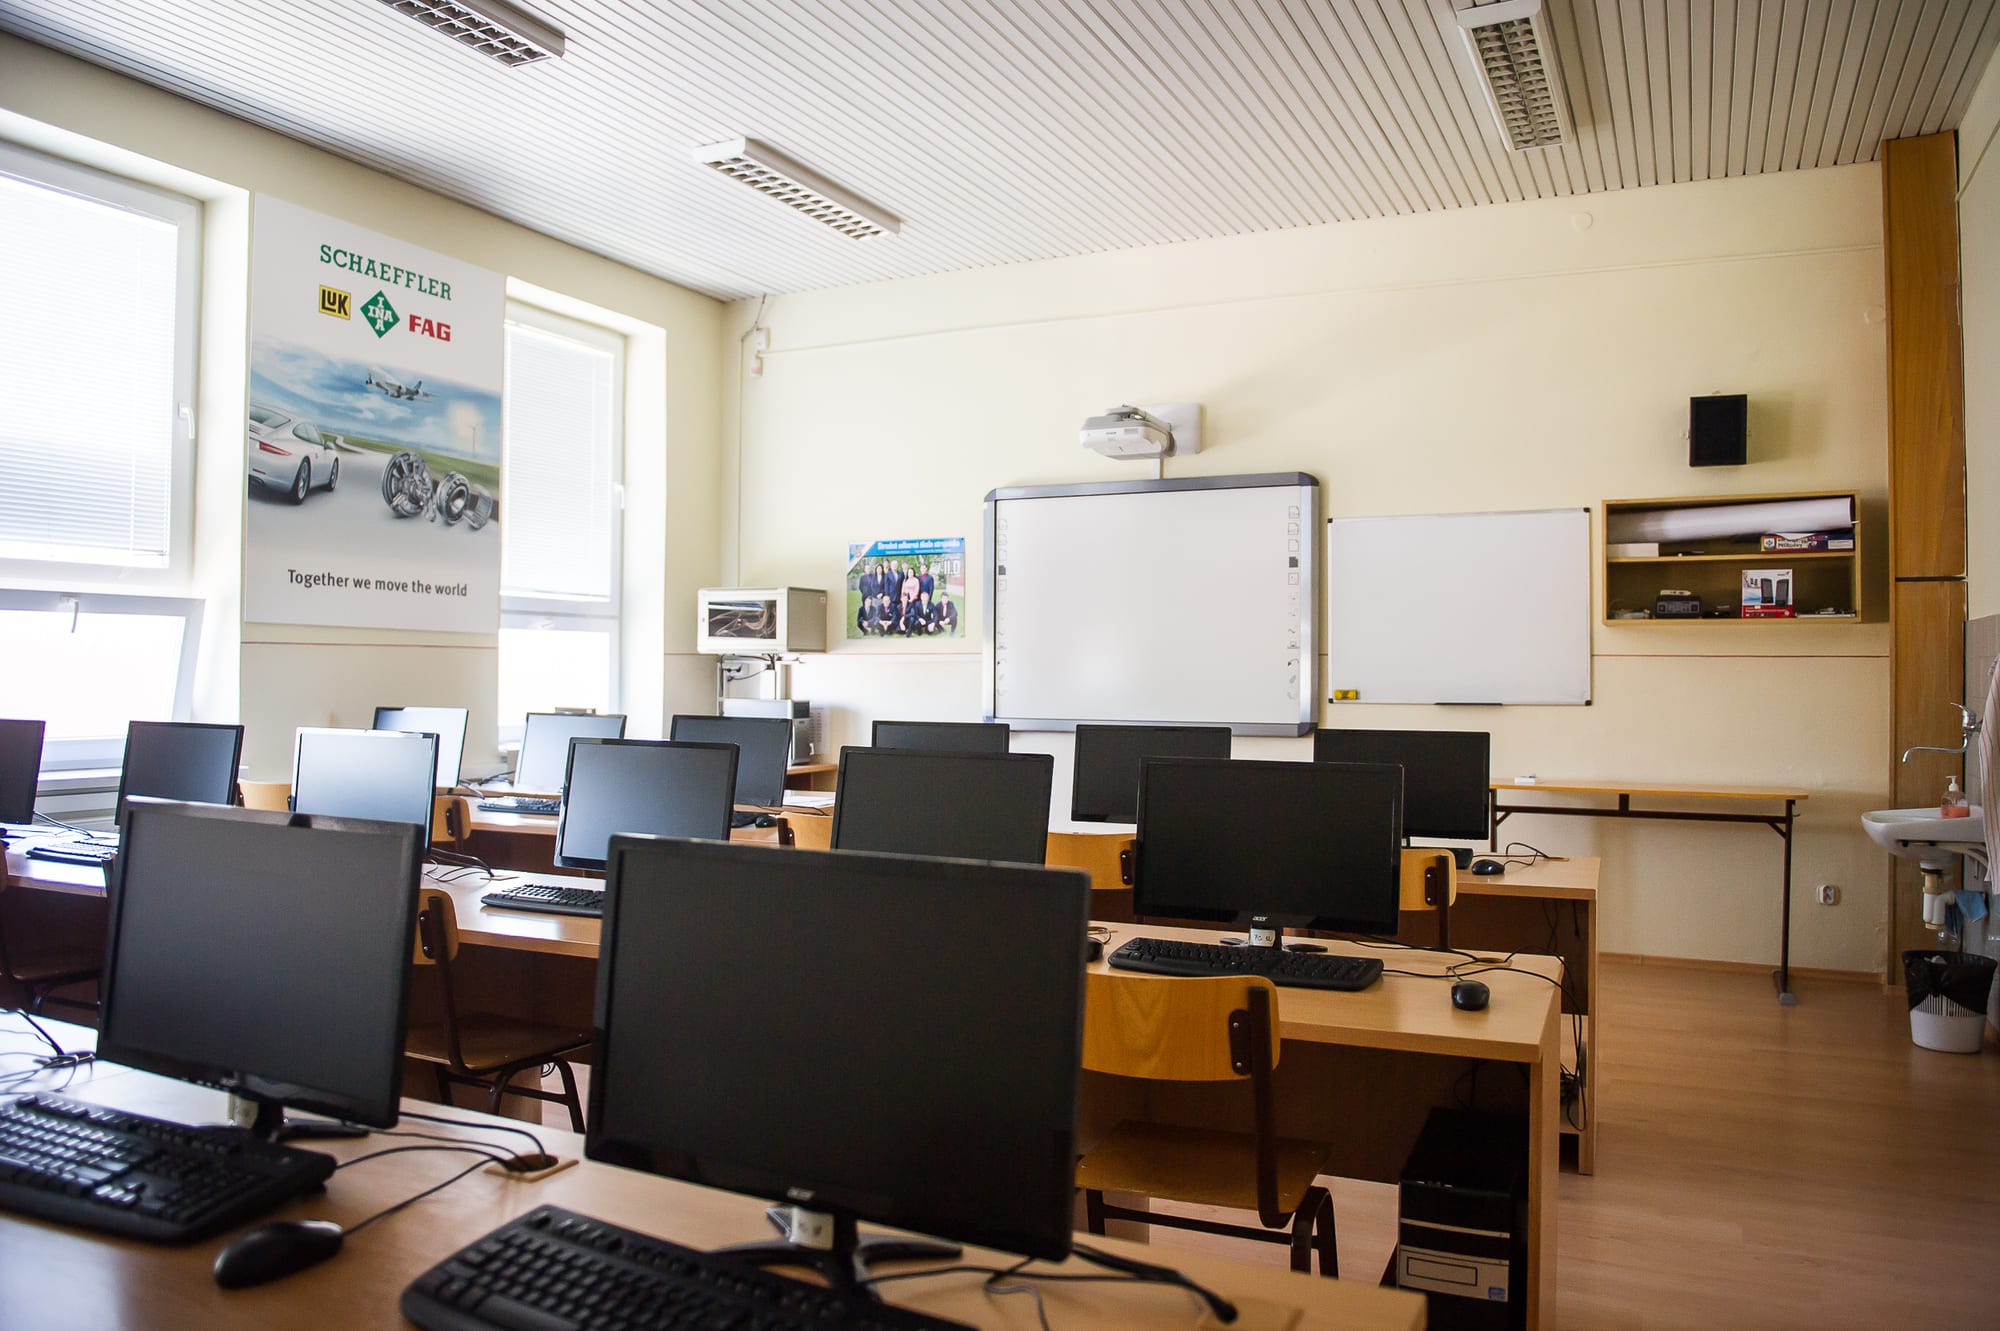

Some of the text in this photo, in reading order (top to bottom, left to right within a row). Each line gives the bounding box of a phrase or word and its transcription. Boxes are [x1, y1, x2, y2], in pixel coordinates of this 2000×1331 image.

[320, 244, 452, 301] SCHAEFFLER
[409, 314, 451, 342] FAG
[288, 569, 468, 597] Together we move the world
